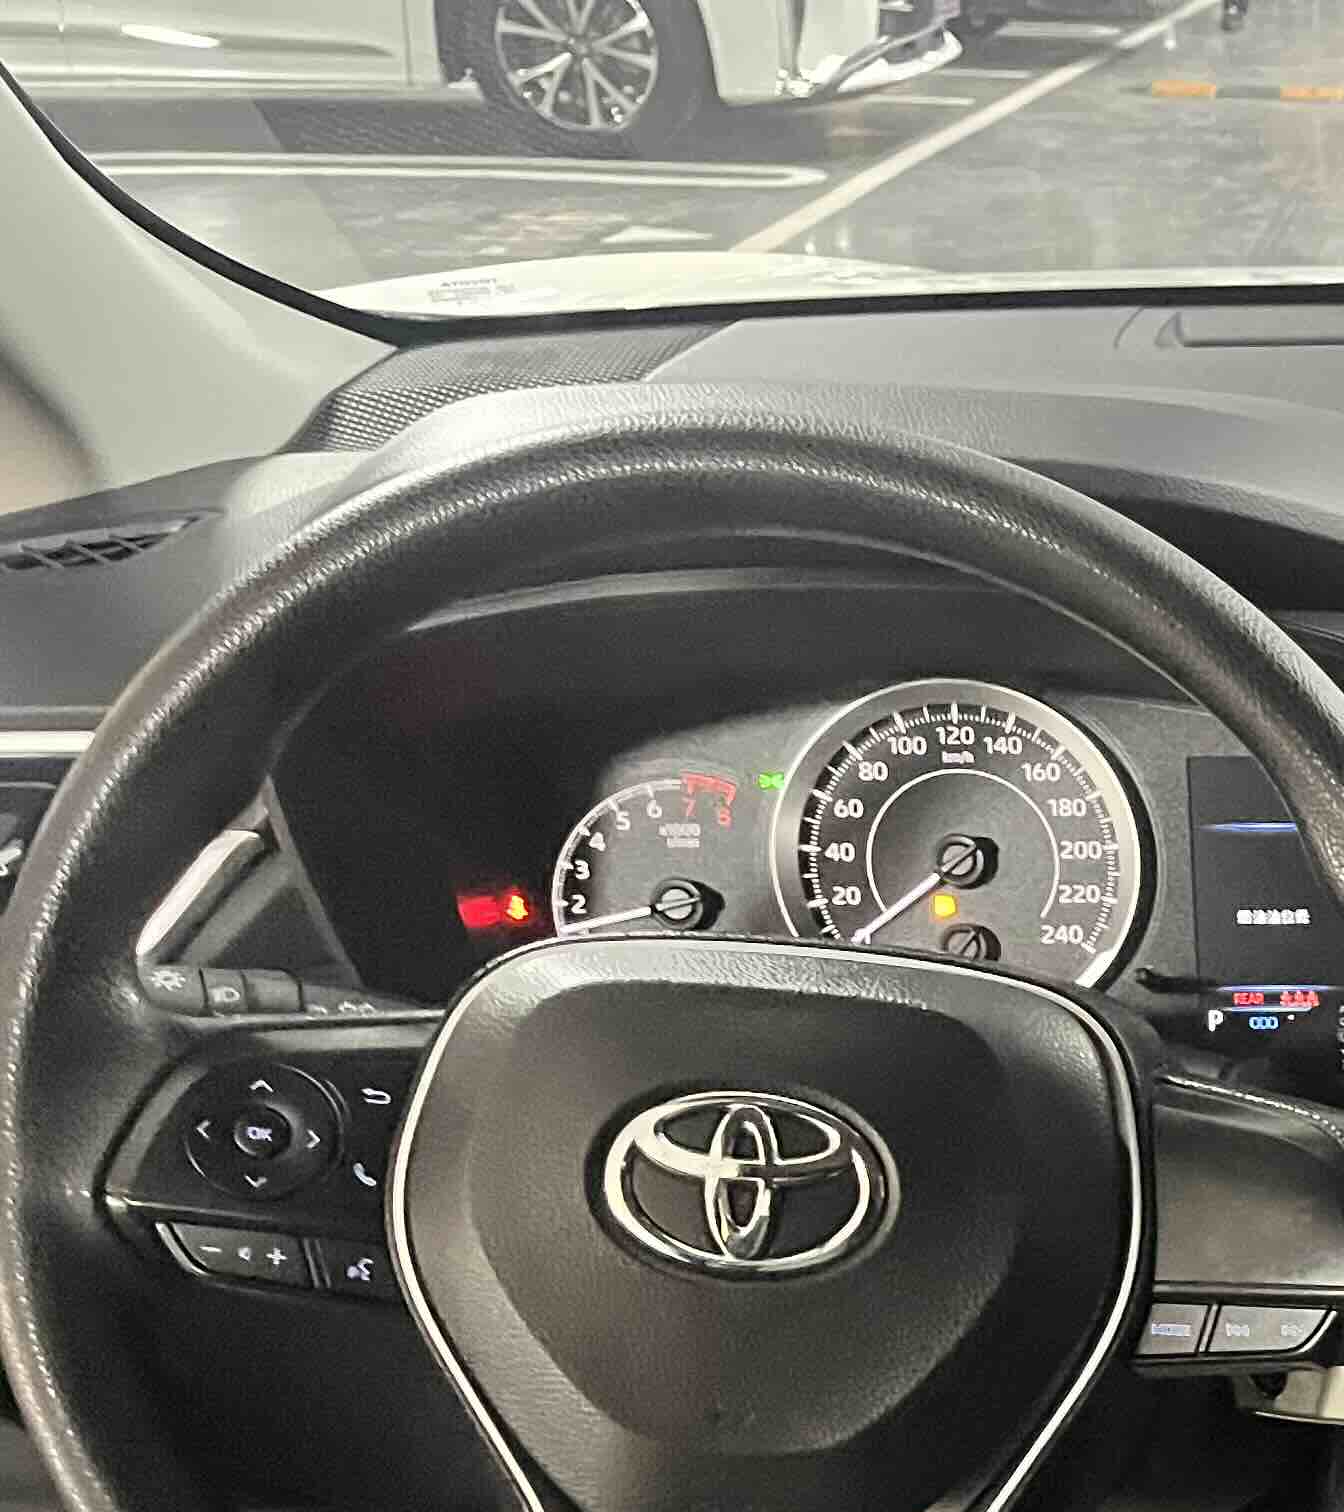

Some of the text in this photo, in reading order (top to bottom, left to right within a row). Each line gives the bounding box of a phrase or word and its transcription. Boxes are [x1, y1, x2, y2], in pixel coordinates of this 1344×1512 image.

[888, 735, 927, 755] 100
[936, 726, 975, 746] 120
[983, 736, 1022, 755] 140
[857, 761, 888, 781] 80
[1021, 763, 1061, 782] 160
[646, 800, 662, 818] 6
[682, 799, 697, 818] 7
[833, 798, 864, 818] 60
[1047, 798, 1087, 817] 180
[615, 811, 631, 830] 5
[588, 832, 606, 851] 4
[1060, 840, 1102, 859] 200
[825, 842, 855, 862] 40
[574, 860, 591, 880] 3
[570, 894, 588, 914] 2
[831, 886, 861, 906] 20
[1058, 885, 1101, 904] 220
[1041, 925, 1083, 944] 240
[1207, 1009, 1224, 1032] P
[247, 1126, 272, 1142] OK
